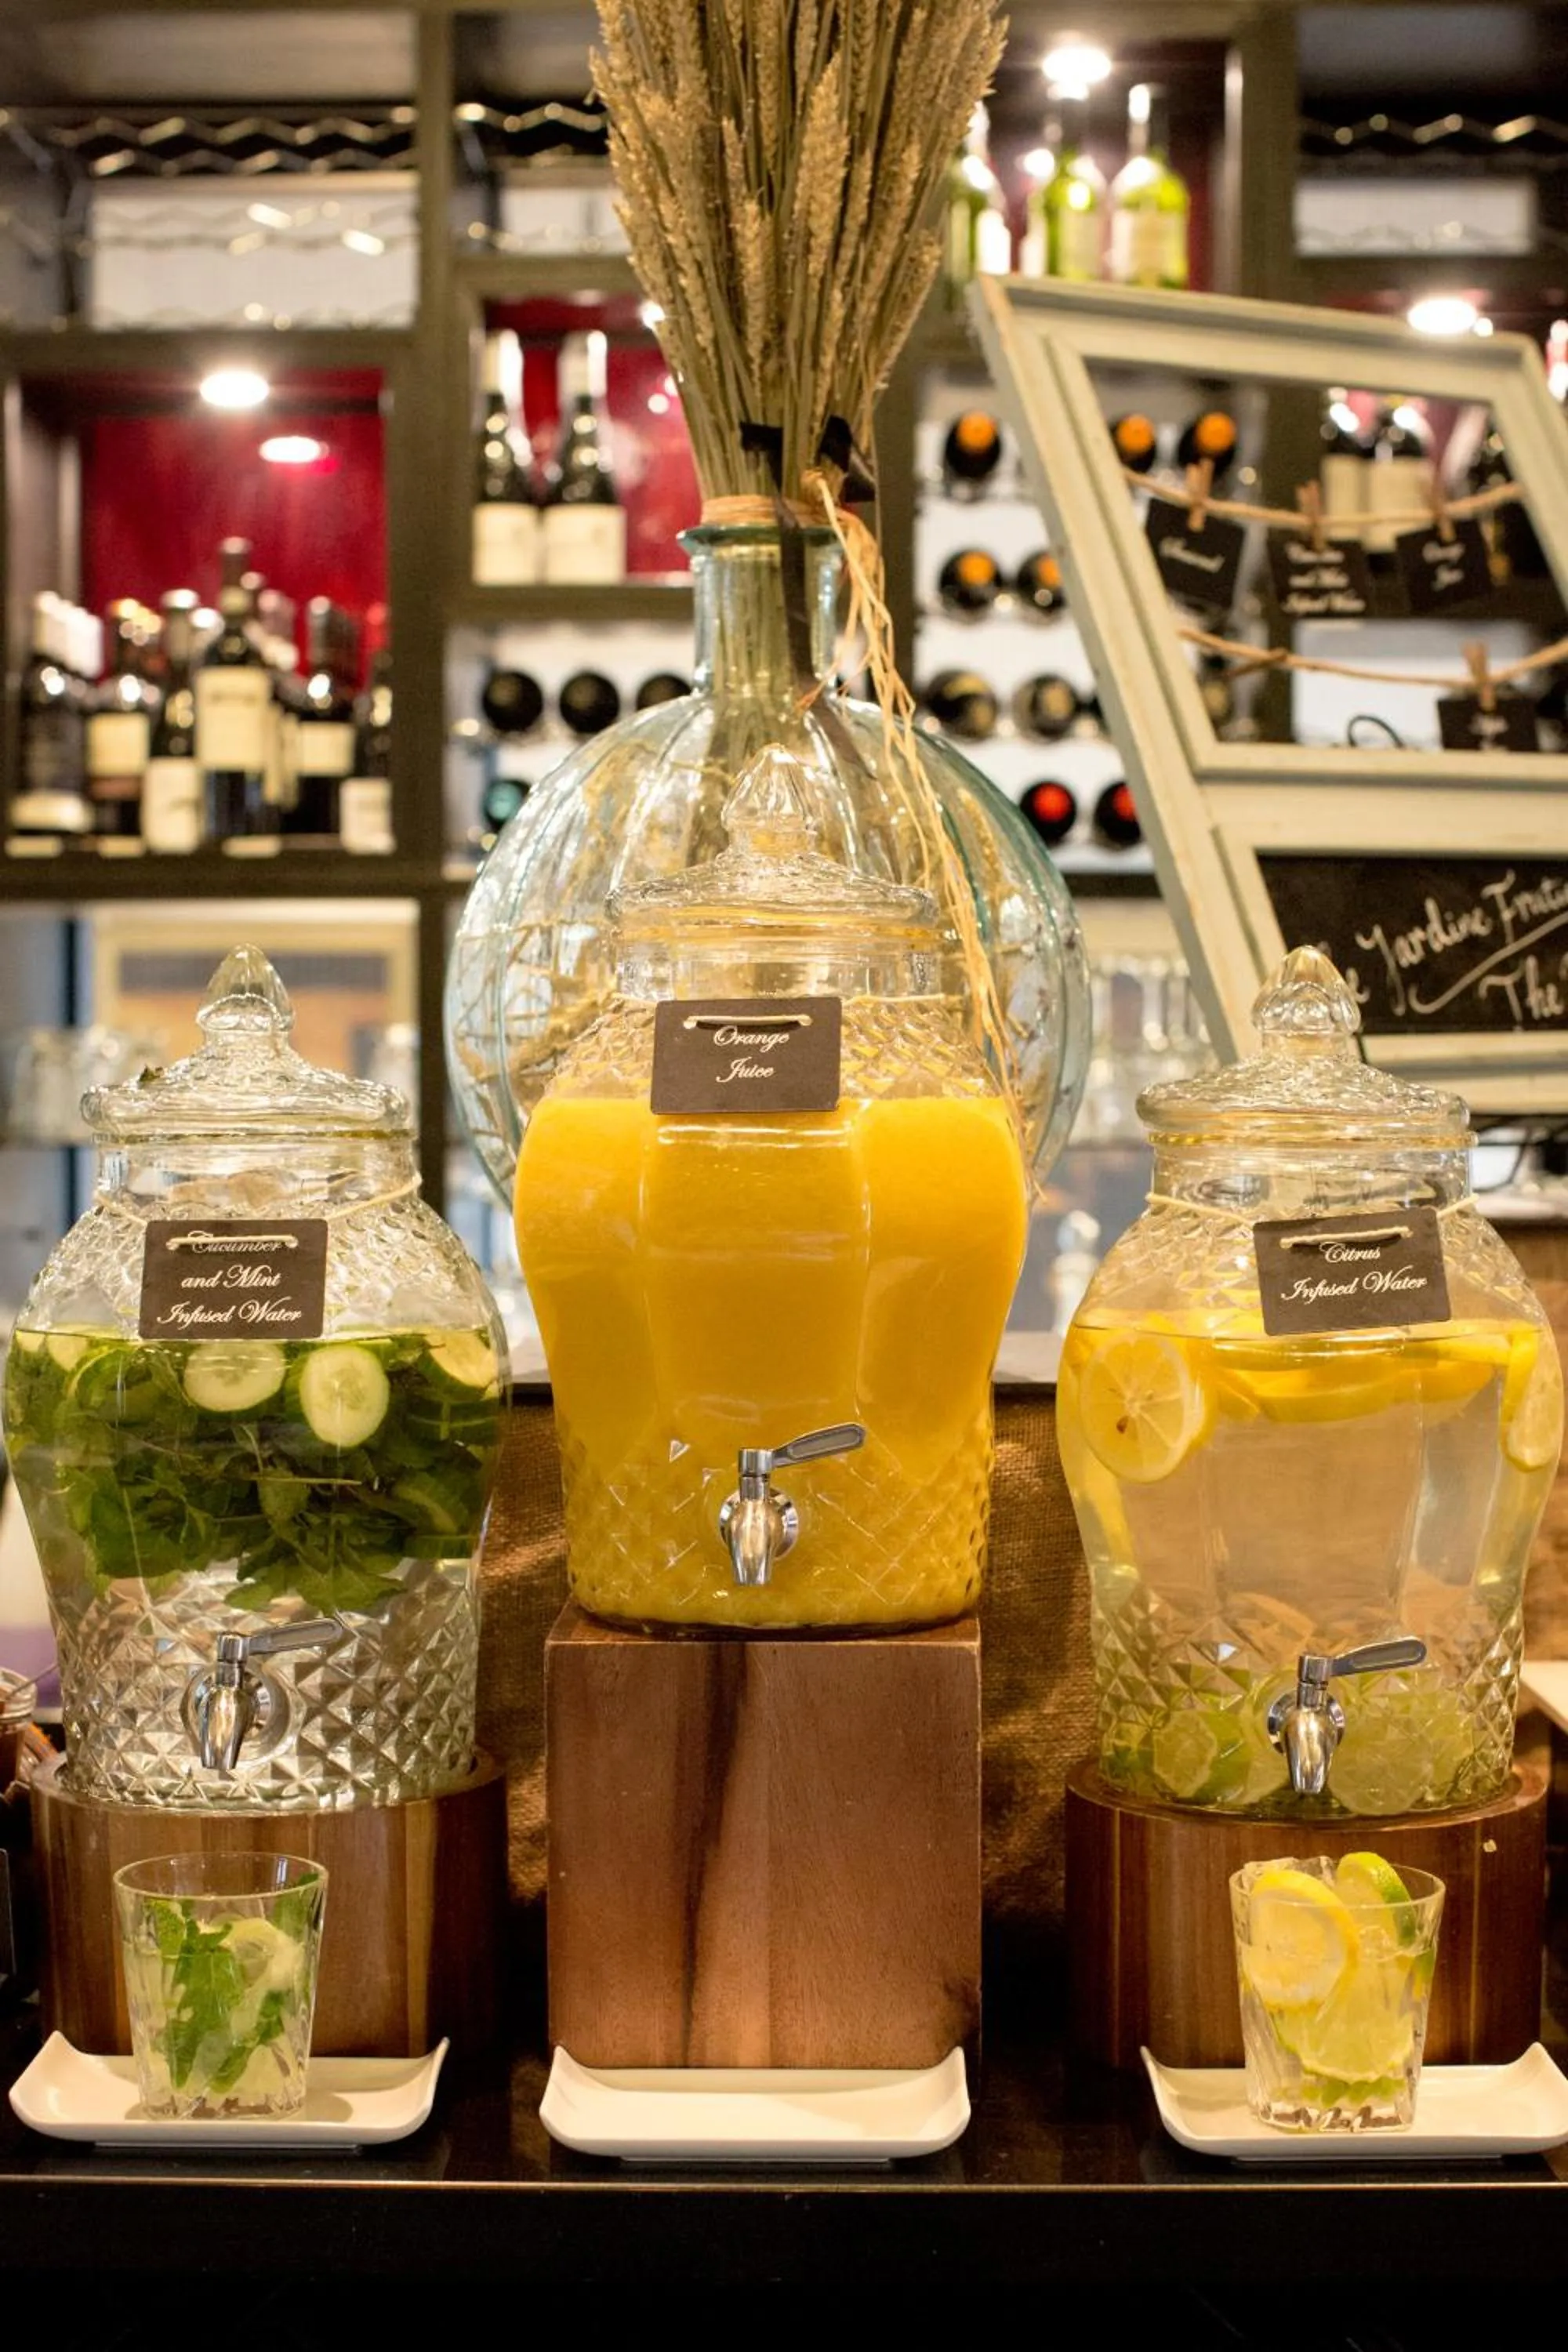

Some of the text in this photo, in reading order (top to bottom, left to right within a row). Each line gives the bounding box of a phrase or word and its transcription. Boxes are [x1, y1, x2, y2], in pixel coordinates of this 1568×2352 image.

[713, 1025, 789, 1053] Orange
[716, 1056, 775, 1083] Juice
[1319, 1241, 1381, 1263] Citrus
[181, 1265, 282, 1288] and Mint
[1281, 1265, 1428, 1305] Infused Water
[157, 1296, 303, 1330] Infused Water
